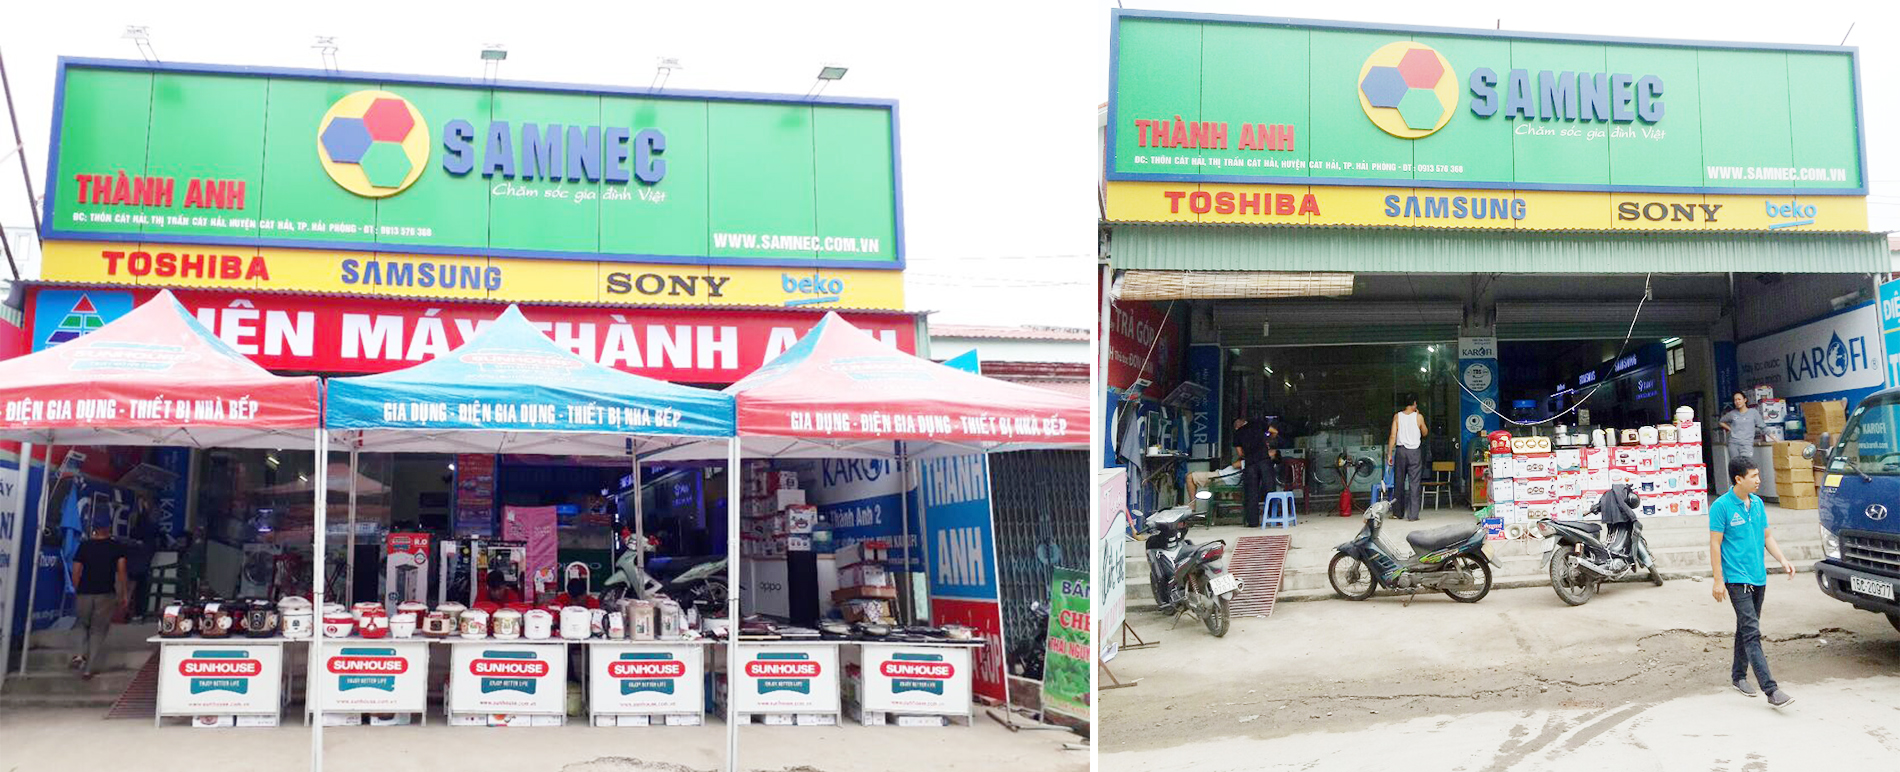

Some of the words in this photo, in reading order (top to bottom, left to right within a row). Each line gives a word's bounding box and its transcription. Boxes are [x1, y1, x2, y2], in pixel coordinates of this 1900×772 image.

[1469, 67, 1665, 125] SAMNEC
[1135, 114, 1228, 150] THÀNH
[1238, 123, 1294, 151] ANH
[1515, 123, 1555, 136] Chăm
[1560, 125, 1582, 137] sóc
[1587, 127, 1606, 141] gia
[1611, 125, 1636, 138] đình
[1641, 127, 1666, 141] Việt
[443, 119, 666, 186] SAMNEC
[1134, 155, 1148, 164] ĐC:
[1209, 158, 1221, 169] THỊ
[1418, 164, 1434, 172] 0913
[1708, 166, 1846, 182] WWW.SAMNEC.COM.VN
[75, 170, 174, 207] THÀNH
[184, 179, 246, 210] ANH
[492, 183, 538, 197] Chăm
[544, 185, 569, 198] sóc
[574, 190, 596, 204] gia
[602, 187, 631, 201] đình
[638, 189, 665, 204] Việt
[1164, 191, 1321, 216] TOSHIBA
[1384, 194, 1528, 222] SAMSUNG
[1618, 202, 1723, 222] SONY
[1766, 201, 1818, 218] beko
[714, 232, 879, 253] WWW.SAMNEC.COM.VN
[102, 250, 270, 282] TOSHIBA
[341, 258, 502, 292] SAMSUNG
[606, 272, 730, 298] SONY
[782, 273, 844, 295] beko
[5, 398, 43, 425] ĐIỆN
[47, 399, 72, 420] GIA
[76, 398, 116, 423] DỤNG
[130, 394, 172, 420] THIẾT
[176, 400, 191, 423] BỊ
[194, 396, 225, 420] NHÀ
[229, 395, 259, 420] BẾP
[384, 401, 406, 422] GIA
[411, 402, 447, 425] DỤNG
[459, 399, 491, 424] ĐIỆN
[495, 403, 517, 423] GIA
[520, 403, 556, 427] DỤNG
[567, 401, 603, 426] THIẾT
[790, 411, 812, 431] GIA
[816, 412, 850, 435] DỤNG
[861, 410, 891, 437] ĐIỆN
[895, 414, 916, 434] GIA
[919, 414, 951, 437] DỤNG
[962, 413, 996, 435] THIẾT
[856, 505, 873, 527] Anh
[875, 504, 882, 524] 2
[937, 526, 986, 586] ANH
[760, 582, 782, 593] oppo
[185, 662, 255, 673] SUNHOUSE
[333, 660, 402, 670] SUNHOUSE
[475, 662, 543, 674] SUNHOUSE
[614, 664, 680, 674] SUNHOUSE
[751, 664, 816, 674] SUNHOUSE
[886, 664, 949, 676] SUNHOUSE
